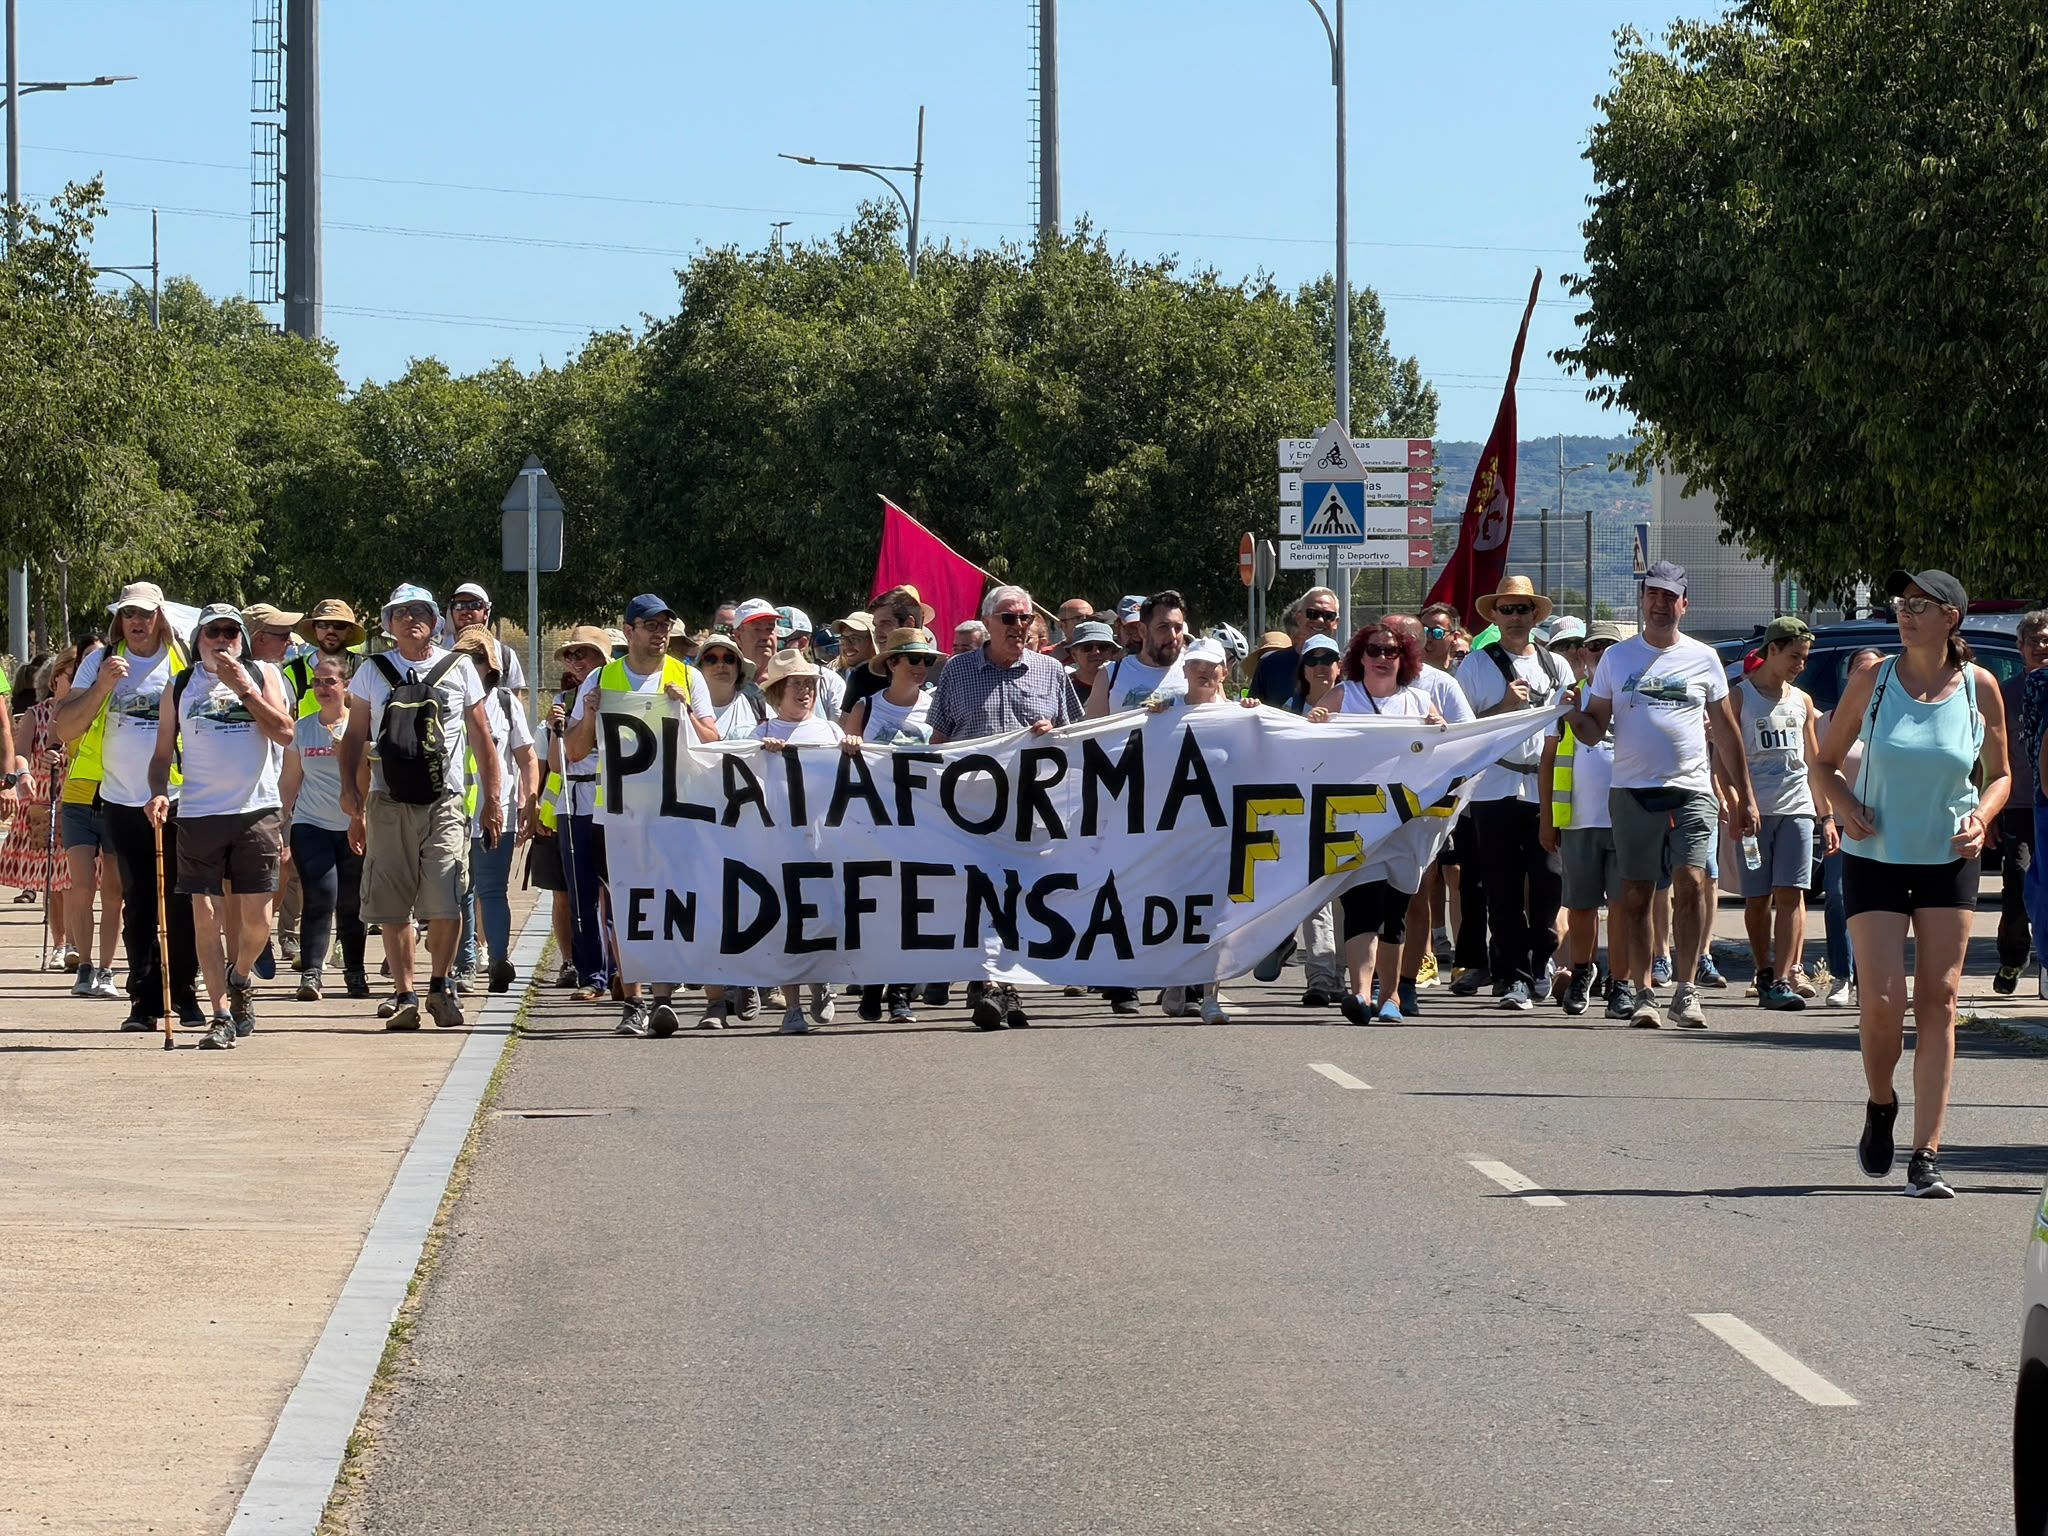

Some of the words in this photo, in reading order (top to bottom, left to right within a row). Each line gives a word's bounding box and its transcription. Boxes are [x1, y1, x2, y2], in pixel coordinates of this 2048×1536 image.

[1352, 440, 1371, 449] icas
[1347, 552, 1390, 562] Deportivo
[1760, 729, 1788, 749] 011
[600, 713, 1228, 841] PLATAFORMA
[626, 887, 697, 943] EN
[720, 856, 1135, 960] DEFENSA
[1142, 893, 1214, 946] DE
